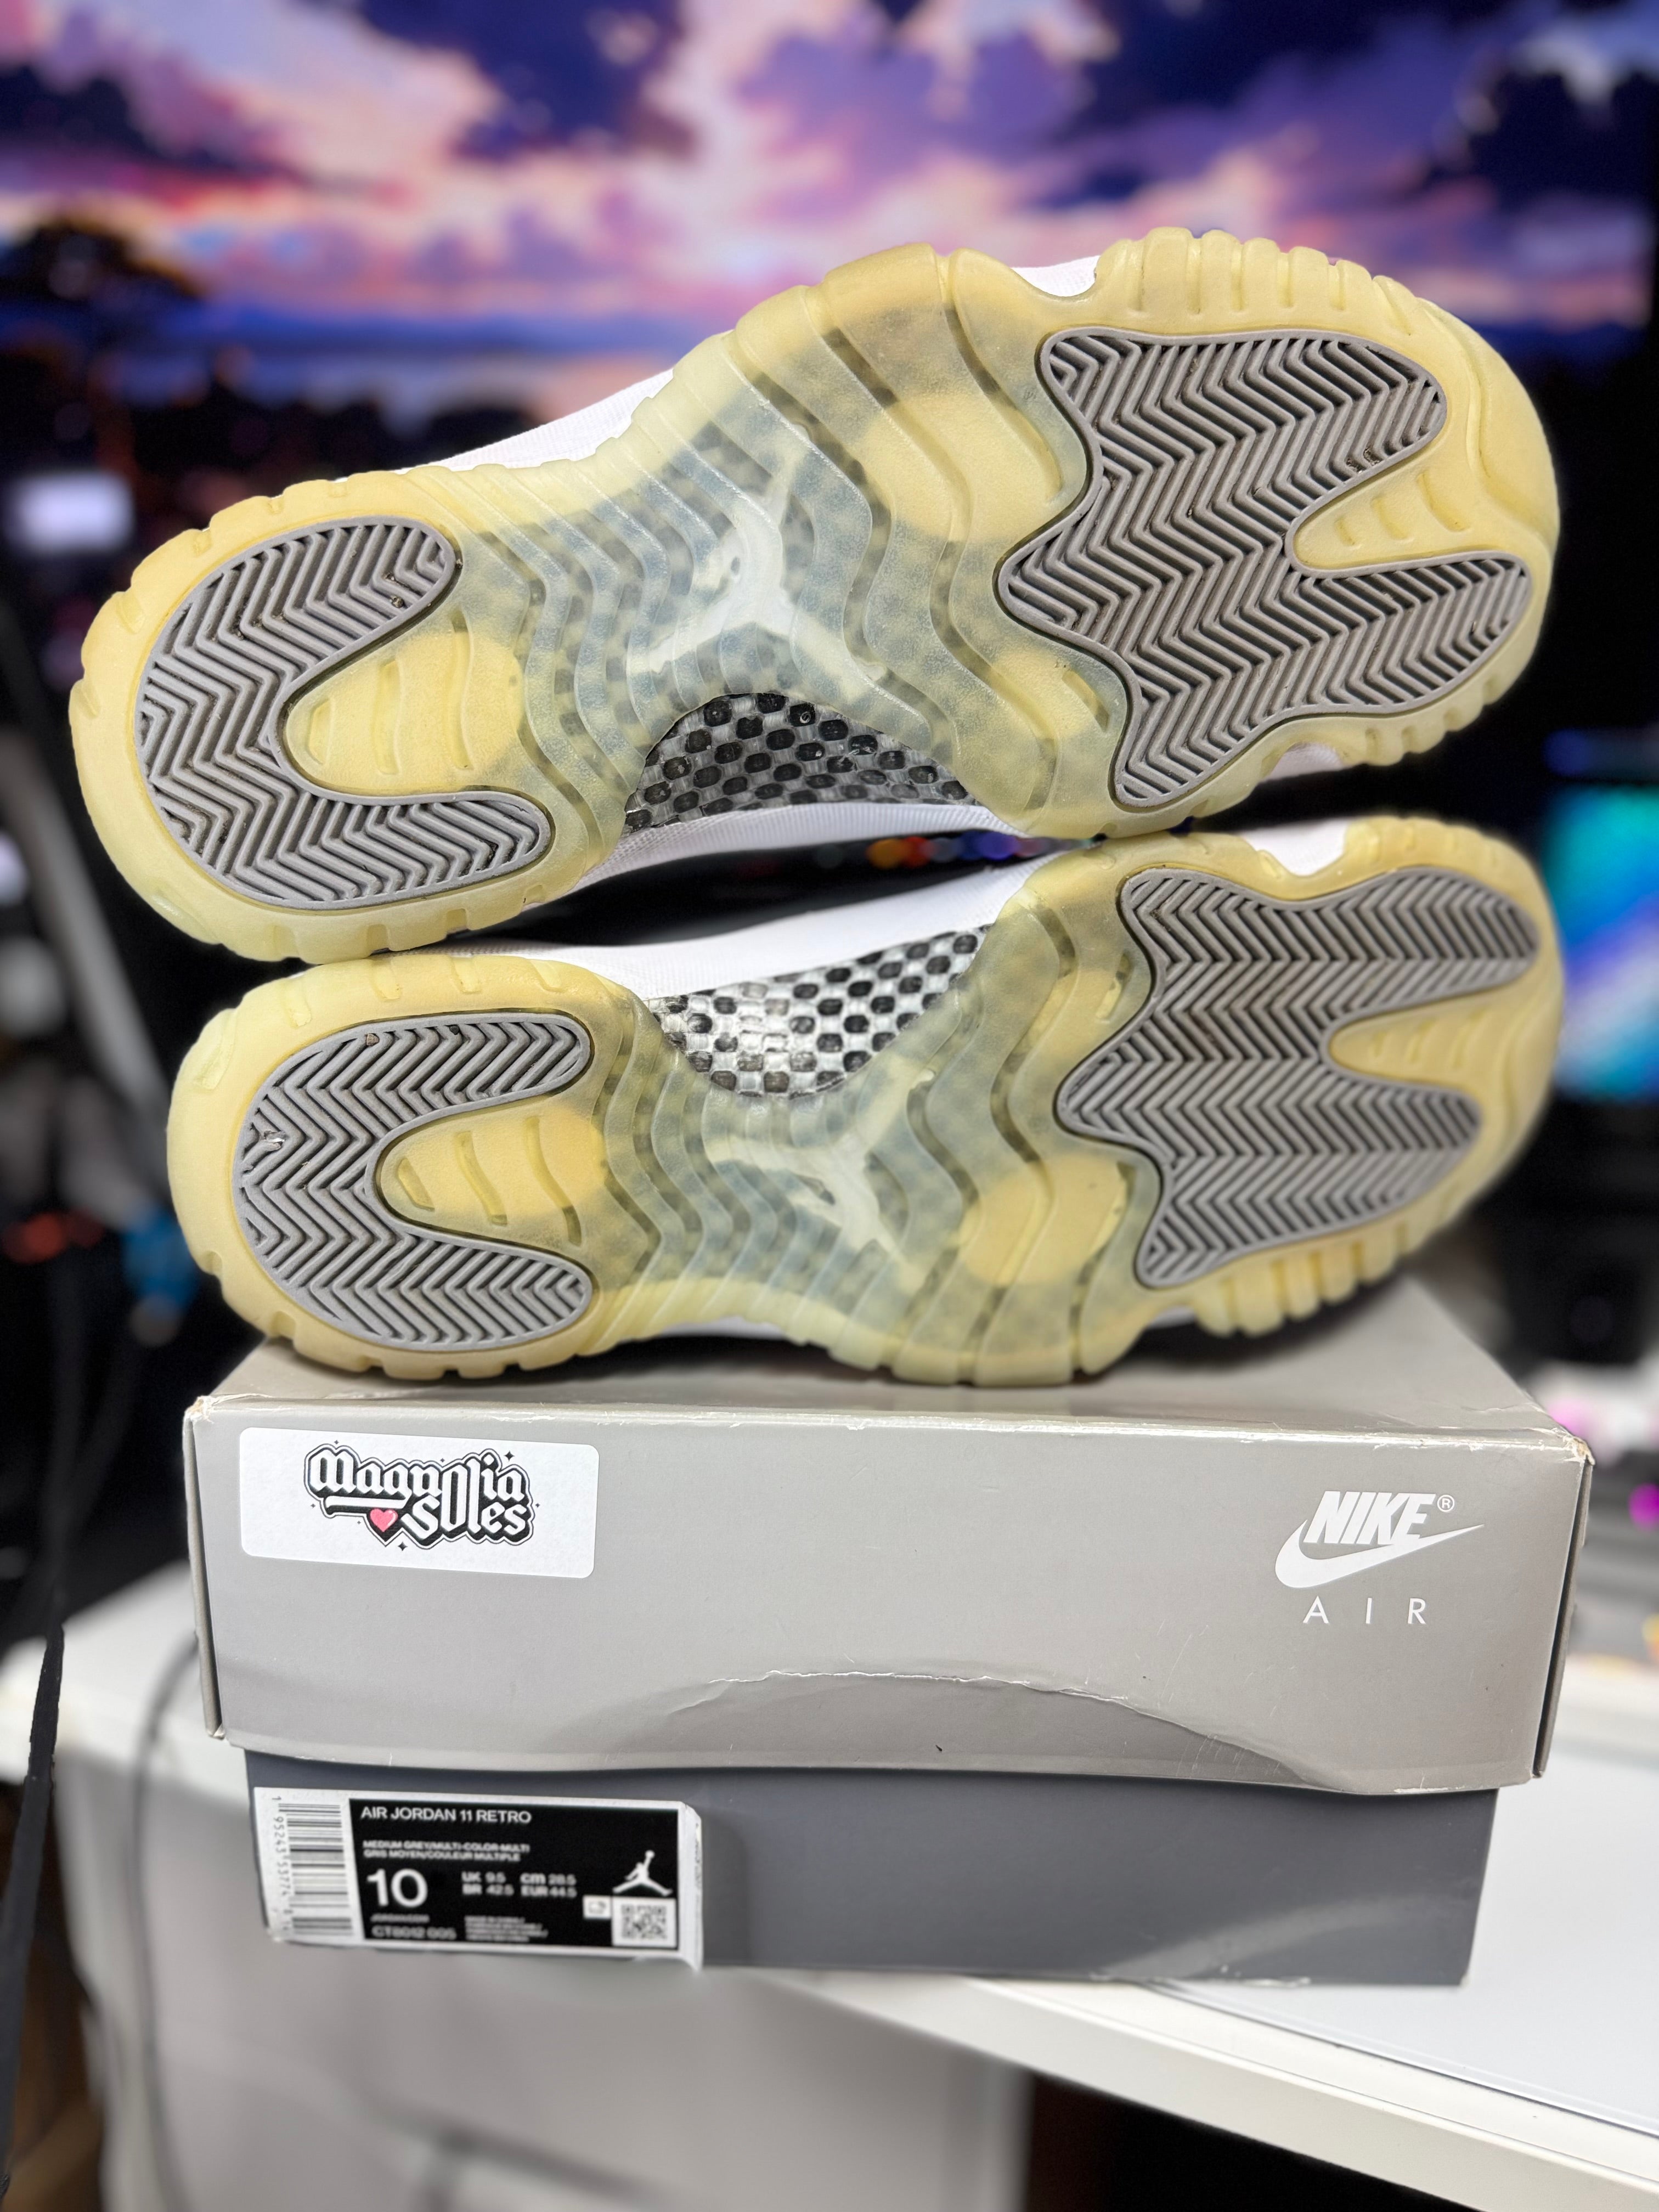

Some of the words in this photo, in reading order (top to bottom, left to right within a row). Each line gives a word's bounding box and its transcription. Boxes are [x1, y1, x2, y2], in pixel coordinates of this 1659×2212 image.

[1303, 1595, 1427, 1624] AIR
[360, 1806, 387, 1819] AIR
[391, 1807, 456, 1821] JORDAN
[460, 1810, 472, 1822] 11
[476, 1810, 532, 1824] RETRO
[363, 1839, 402, 1849] MEDIUM
[461, 1871, 482, 1883] UK
[520, 1872, 546, 1884] cm
[367, 1868, 427, 1908] 10
